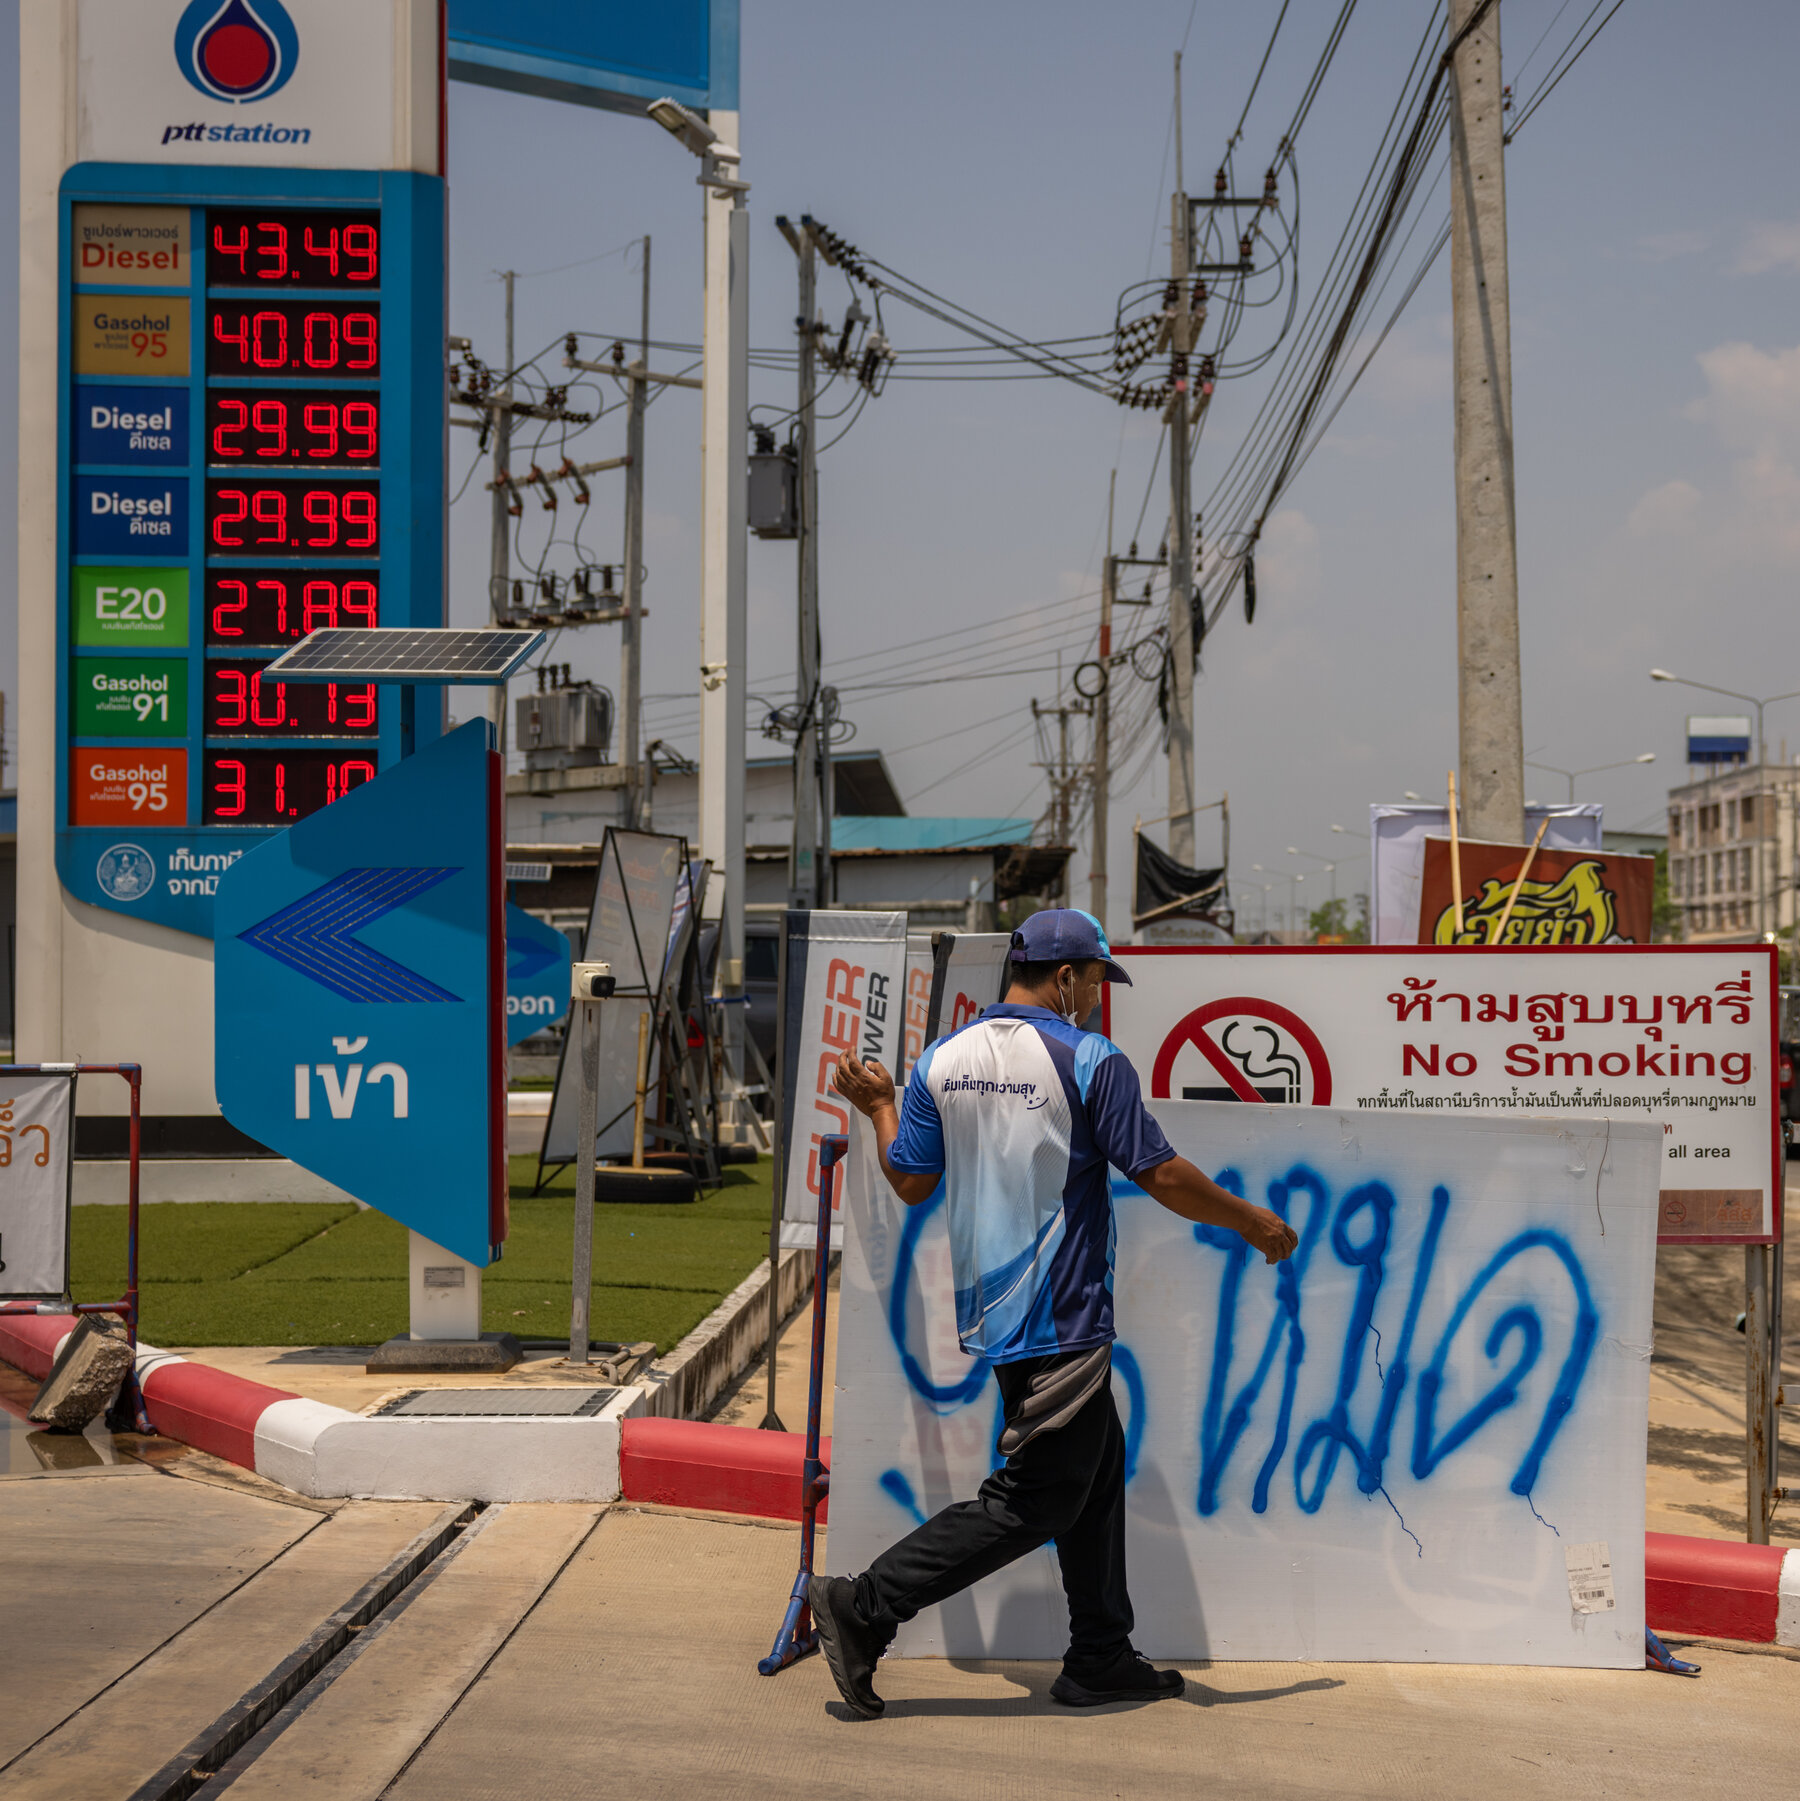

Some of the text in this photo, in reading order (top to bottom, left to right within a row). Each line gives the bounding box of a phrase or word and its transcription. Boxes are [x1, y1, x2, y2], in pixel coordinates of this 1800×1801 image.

[82, 243, 179, 269] Diesel
[214, 223, 377, 279] 43.49
[94, 313, 170, 331] Gasohol
[131, 332, 168, 358] 95
[214, 312, 377, 368] 40.09
[91, 406, 171, 430] Diesel
[213, 400, 377, 457] 29.99
[129, 431, 171, 450] ดีเซล
[91, 492, 171, 515] Diesel
[129, 516, 171, 535] ดีเซล
[213, 490, 376, 547] 29.99
[96, 587, 166, 620] E20
[213, 580, 376, 636] 27.89
[92, 674, 168, 691] Gasohol
[132, 693, 168, 721] 91
[90, 764, 167, 781] Gasohol
[128, 783, 168, 811] 95
[506, 995, 556, 1016] ออก
[1386, 970, 1754, 1042] ห้ามสูบบุหรี่
[1402, 1043, 1753, 1085] No Smoking
[294, 1036, 409, 1120] เข้า
[1668, 1145, 1731, 1159] all area
